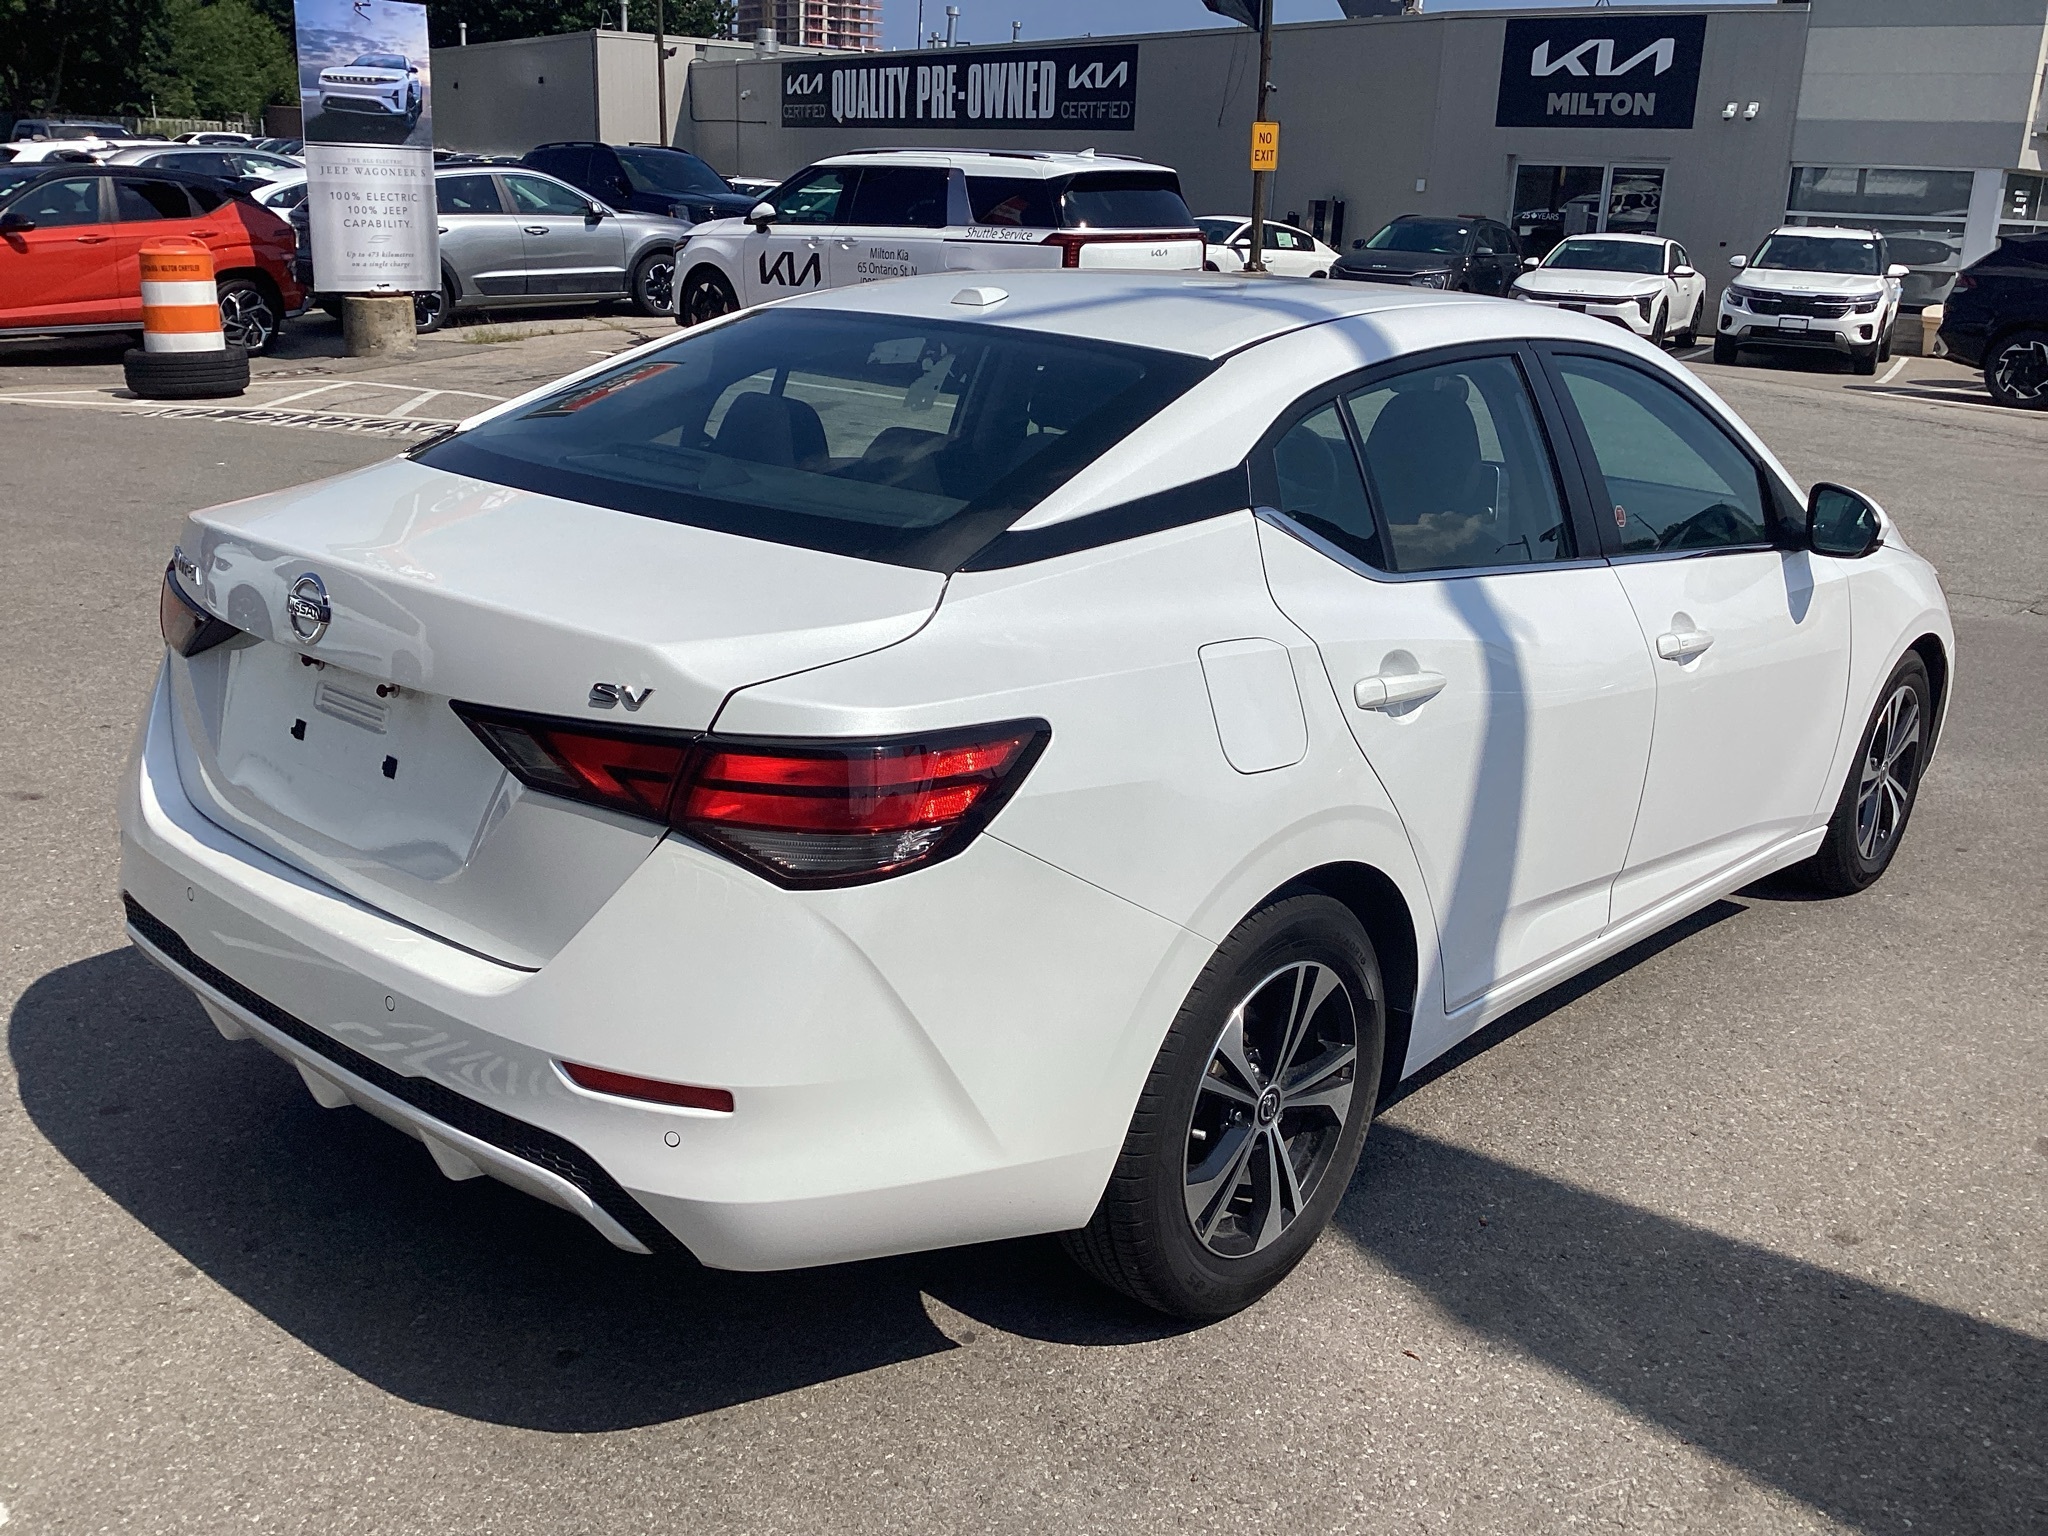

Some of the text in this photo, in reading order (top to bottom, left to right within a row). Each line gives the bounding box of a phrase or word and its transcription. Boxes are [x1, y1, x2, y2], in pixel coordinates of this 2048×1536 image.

[831, 61, 1056, 124] QUALITY PRE-OWNED
[1546, 92, 1656, 116] MILTON
[1258, 132, 1272, 144] NO
[1254, 149, 1275, 161] EXIT
[320, 165, 426, 177] JEEP WAGONEER S
[330, 191, 418, 202] 100% ELECTRIC
[347, 205, 408, 215] 100% JEEP
[1521, 211, 1560, 221] 25 YEARS
[343, 219, 413, 229] CAPABILITY.
[965, 226, 1033, 241] Shuttle Service
[869, 247, 909, 261] Milton Kia
[857, 261, 867, 274] 65
[868, 262, 898, 276] Ontario
[899, 264, 910, 277] St.
[588, 682, 656, 711] SV
